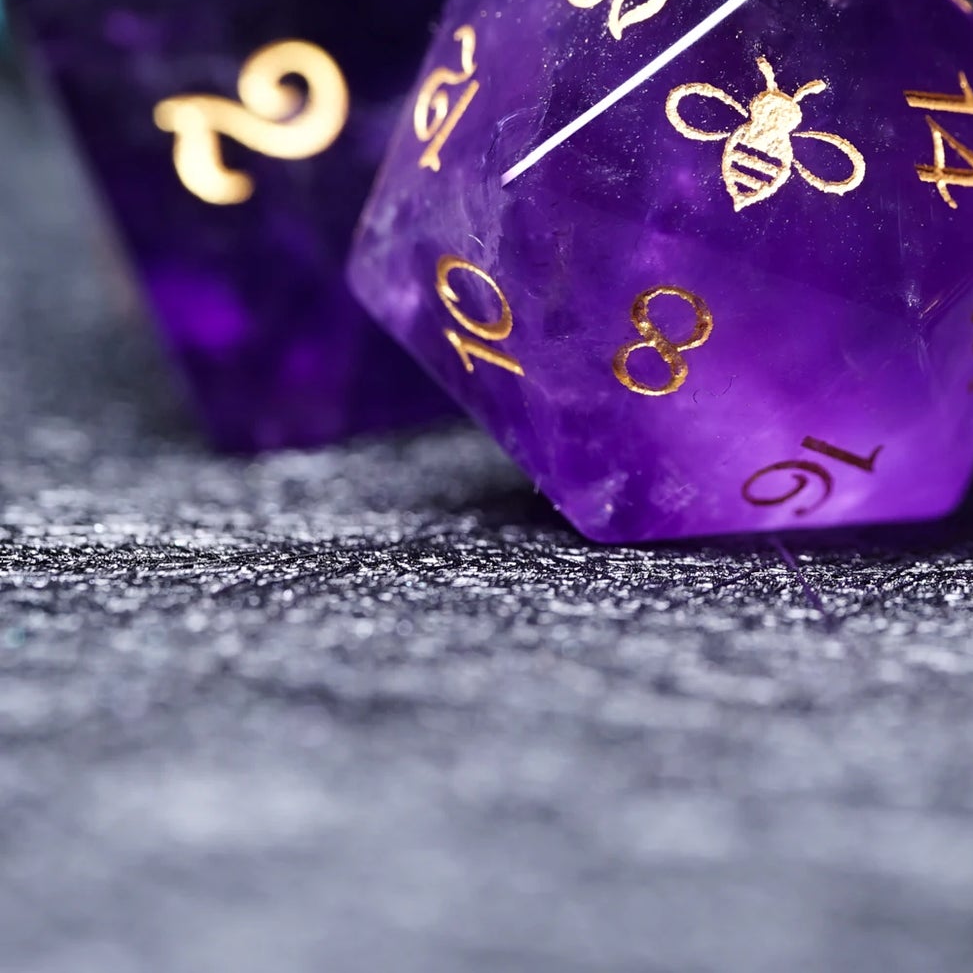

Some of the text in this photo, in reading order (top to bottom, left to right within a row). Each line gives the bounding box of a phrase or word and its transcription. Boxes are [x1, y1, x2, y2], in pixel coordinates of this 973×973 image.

[153, 37, 350, 205] 2
[436, 254, 525, 377] 10
[611, 285, 713, 396] 8
[741, 434, 885, 517] 16
